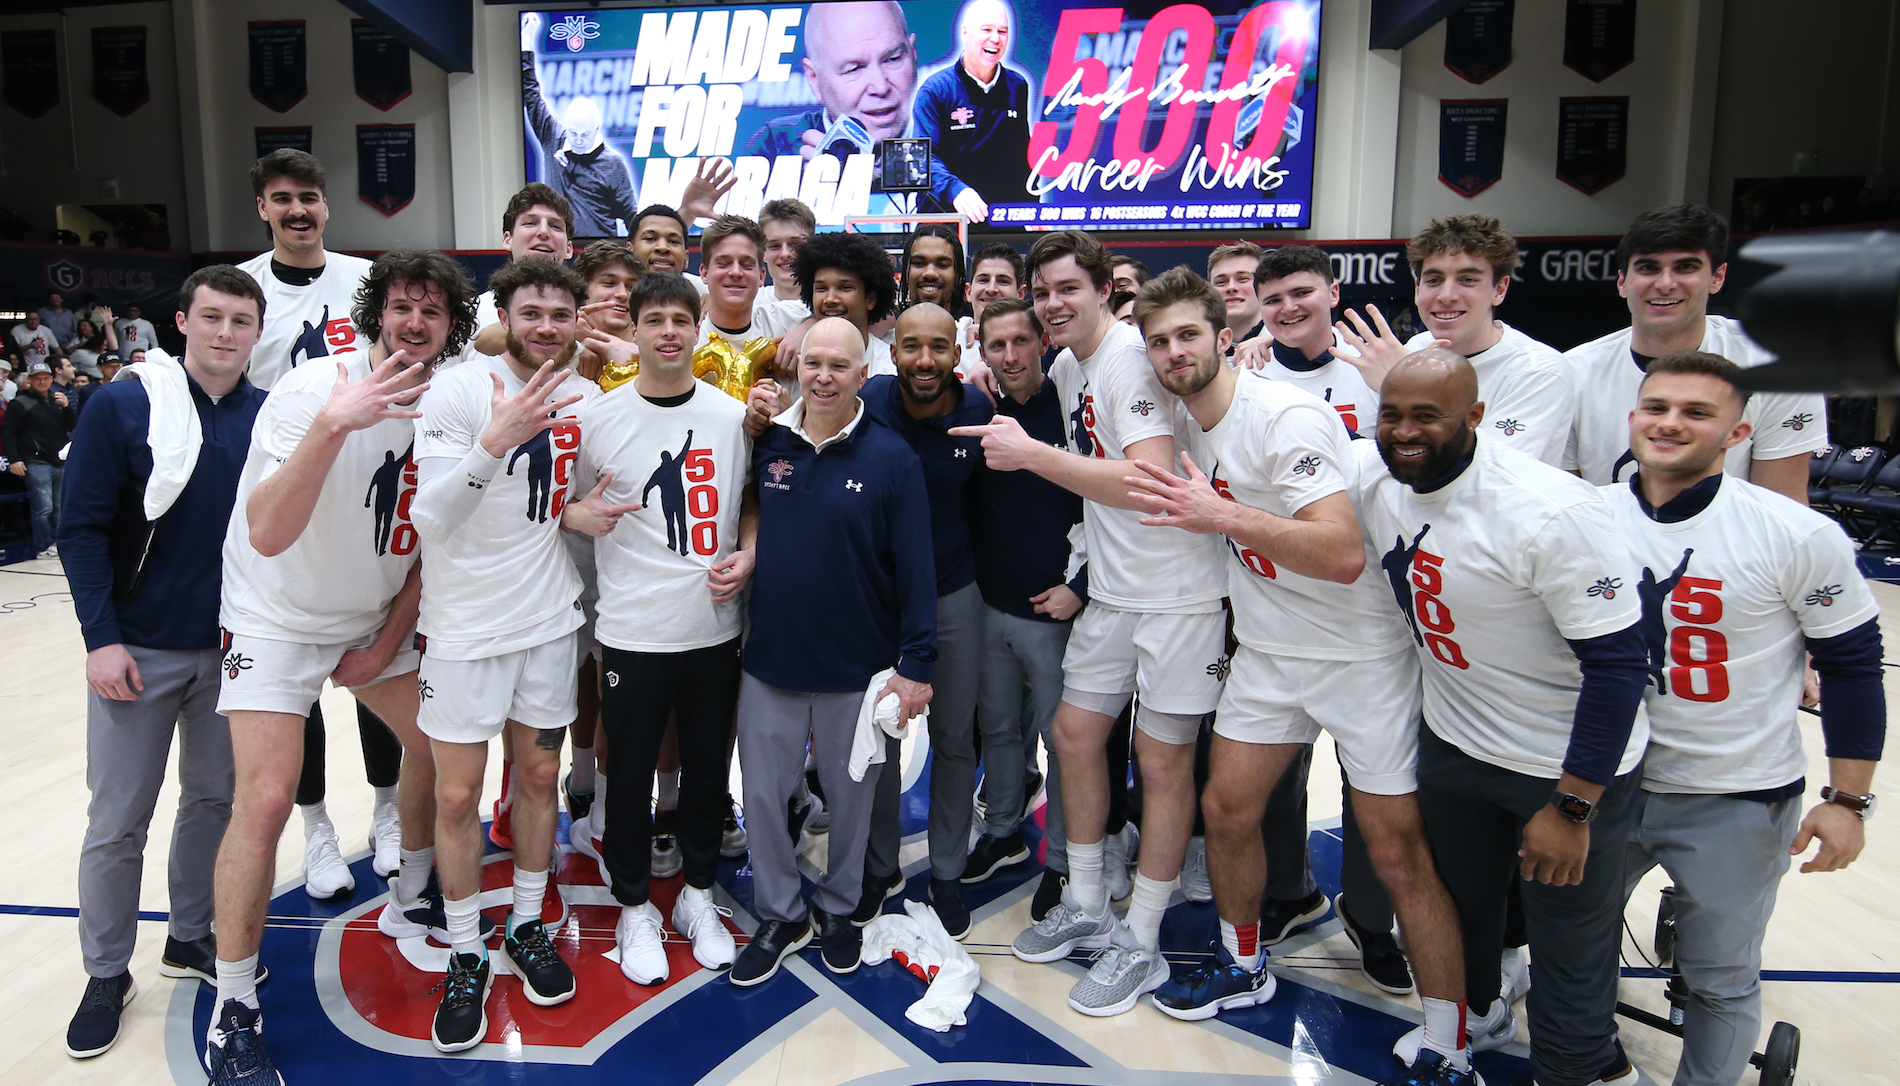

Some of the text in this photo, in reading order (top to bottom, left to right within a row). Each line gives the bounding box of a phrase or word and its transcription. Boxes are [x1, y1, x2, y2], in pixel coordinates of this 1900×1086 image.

[630, 8, 803, 86] MADE
[632, 83, 744, 157] FOR
[1026, 1, 1311, 179] 500
[1026, 142, 1289, 196] Career Wins
[991, 209, 1006, 222] 22
[1007, 208, 1036, 221] YEARS
[1040, 207, 1060, 220] 500
[1061, 207, 1086, 220] WINS
[1090, 206, 1102, 219] 16
[1102, 205, 1167, 219] POSTSEASONS
[1186, 205, 1208, 218] WCC
[1209, 204, 1241, 218] COACH
[1242, 204, 1255, 218] OF
[1256, 204, 1274, 218] THE
[1274, 203, 1301, 218] YEAR
[1331, 252, 1400, 285] OME
[1540, 249, 1619, 282] GAEL
[685, 448, 719, 556] 500
[1412, 548, 1471, 670] 500
[1670, 576, 1730, 703] 500
